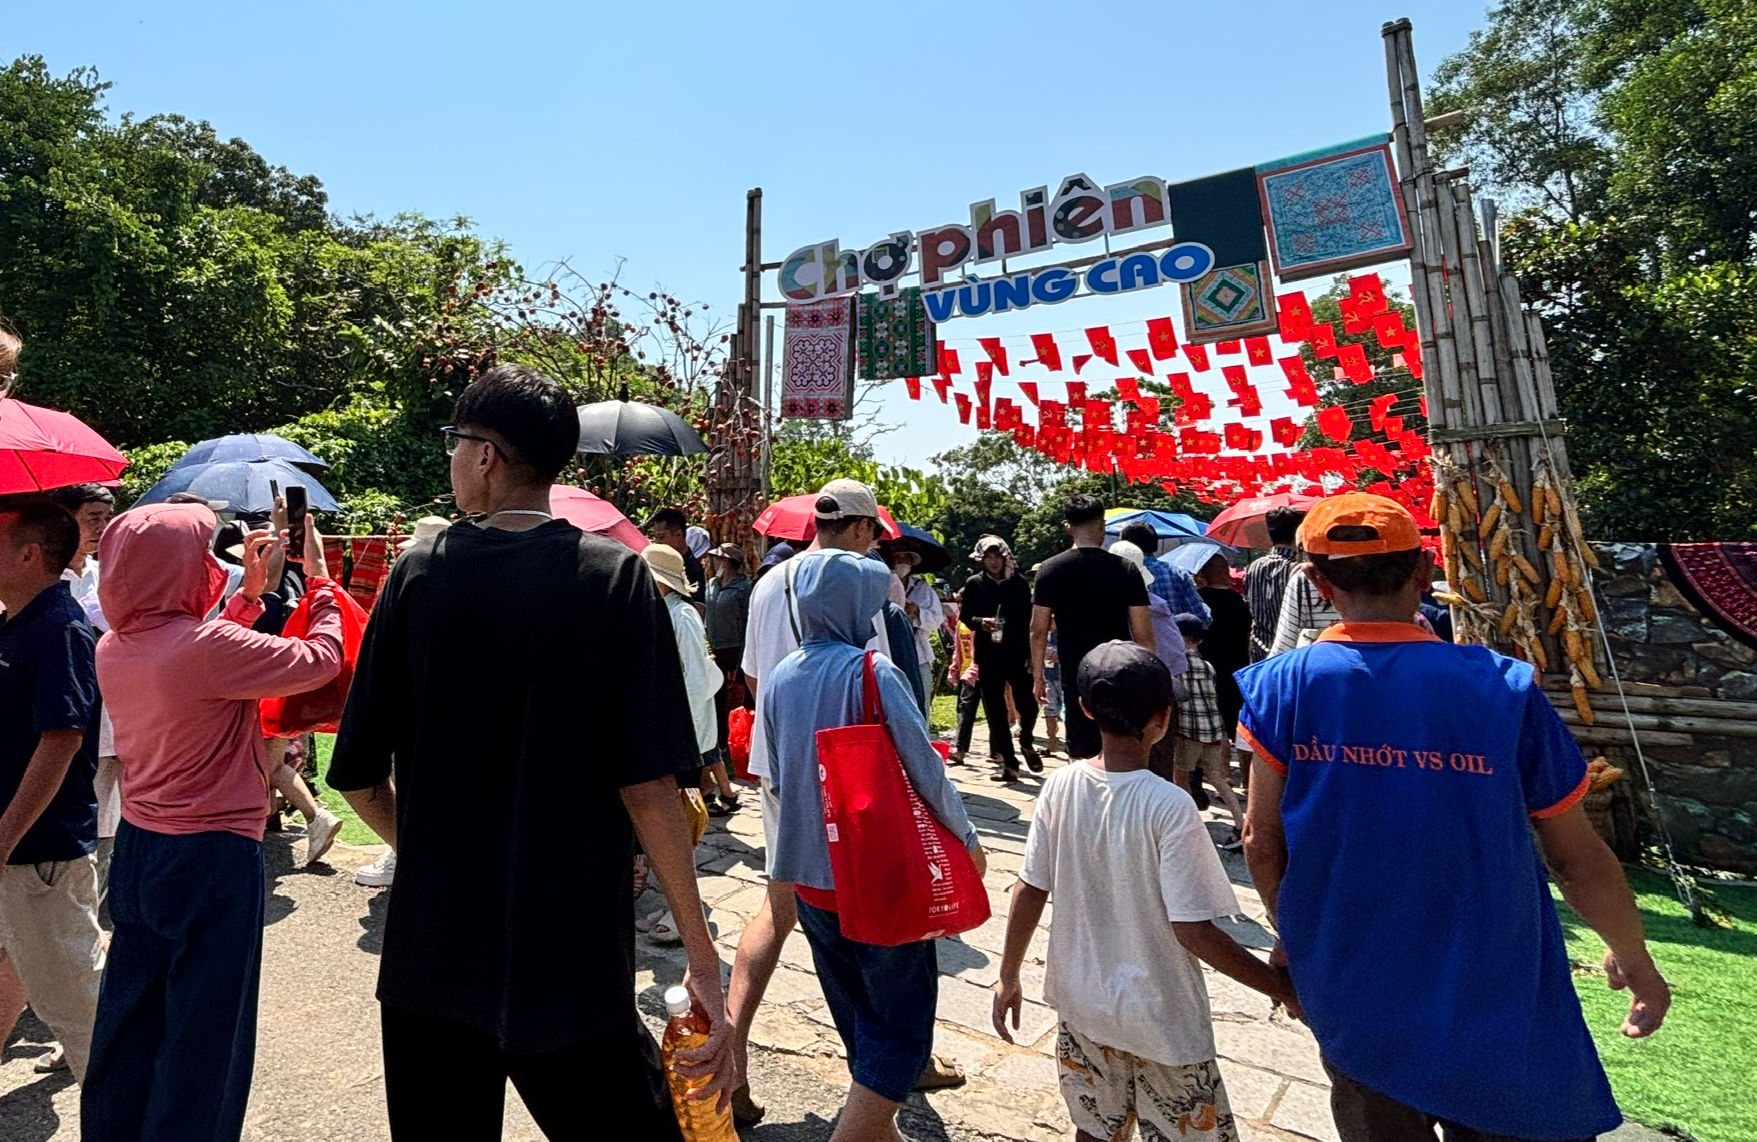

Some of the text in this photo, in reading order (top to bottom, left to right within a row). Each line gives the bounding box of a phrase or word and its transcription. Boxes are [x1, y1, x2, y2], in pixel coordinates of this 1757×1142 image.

[779, 174, 1169, 300] Chợ phiên
[924, 244, 1213, 322] VÙNG CAO
[1293, 735, 1493, 775] DẦU NHỚT VS OIL
